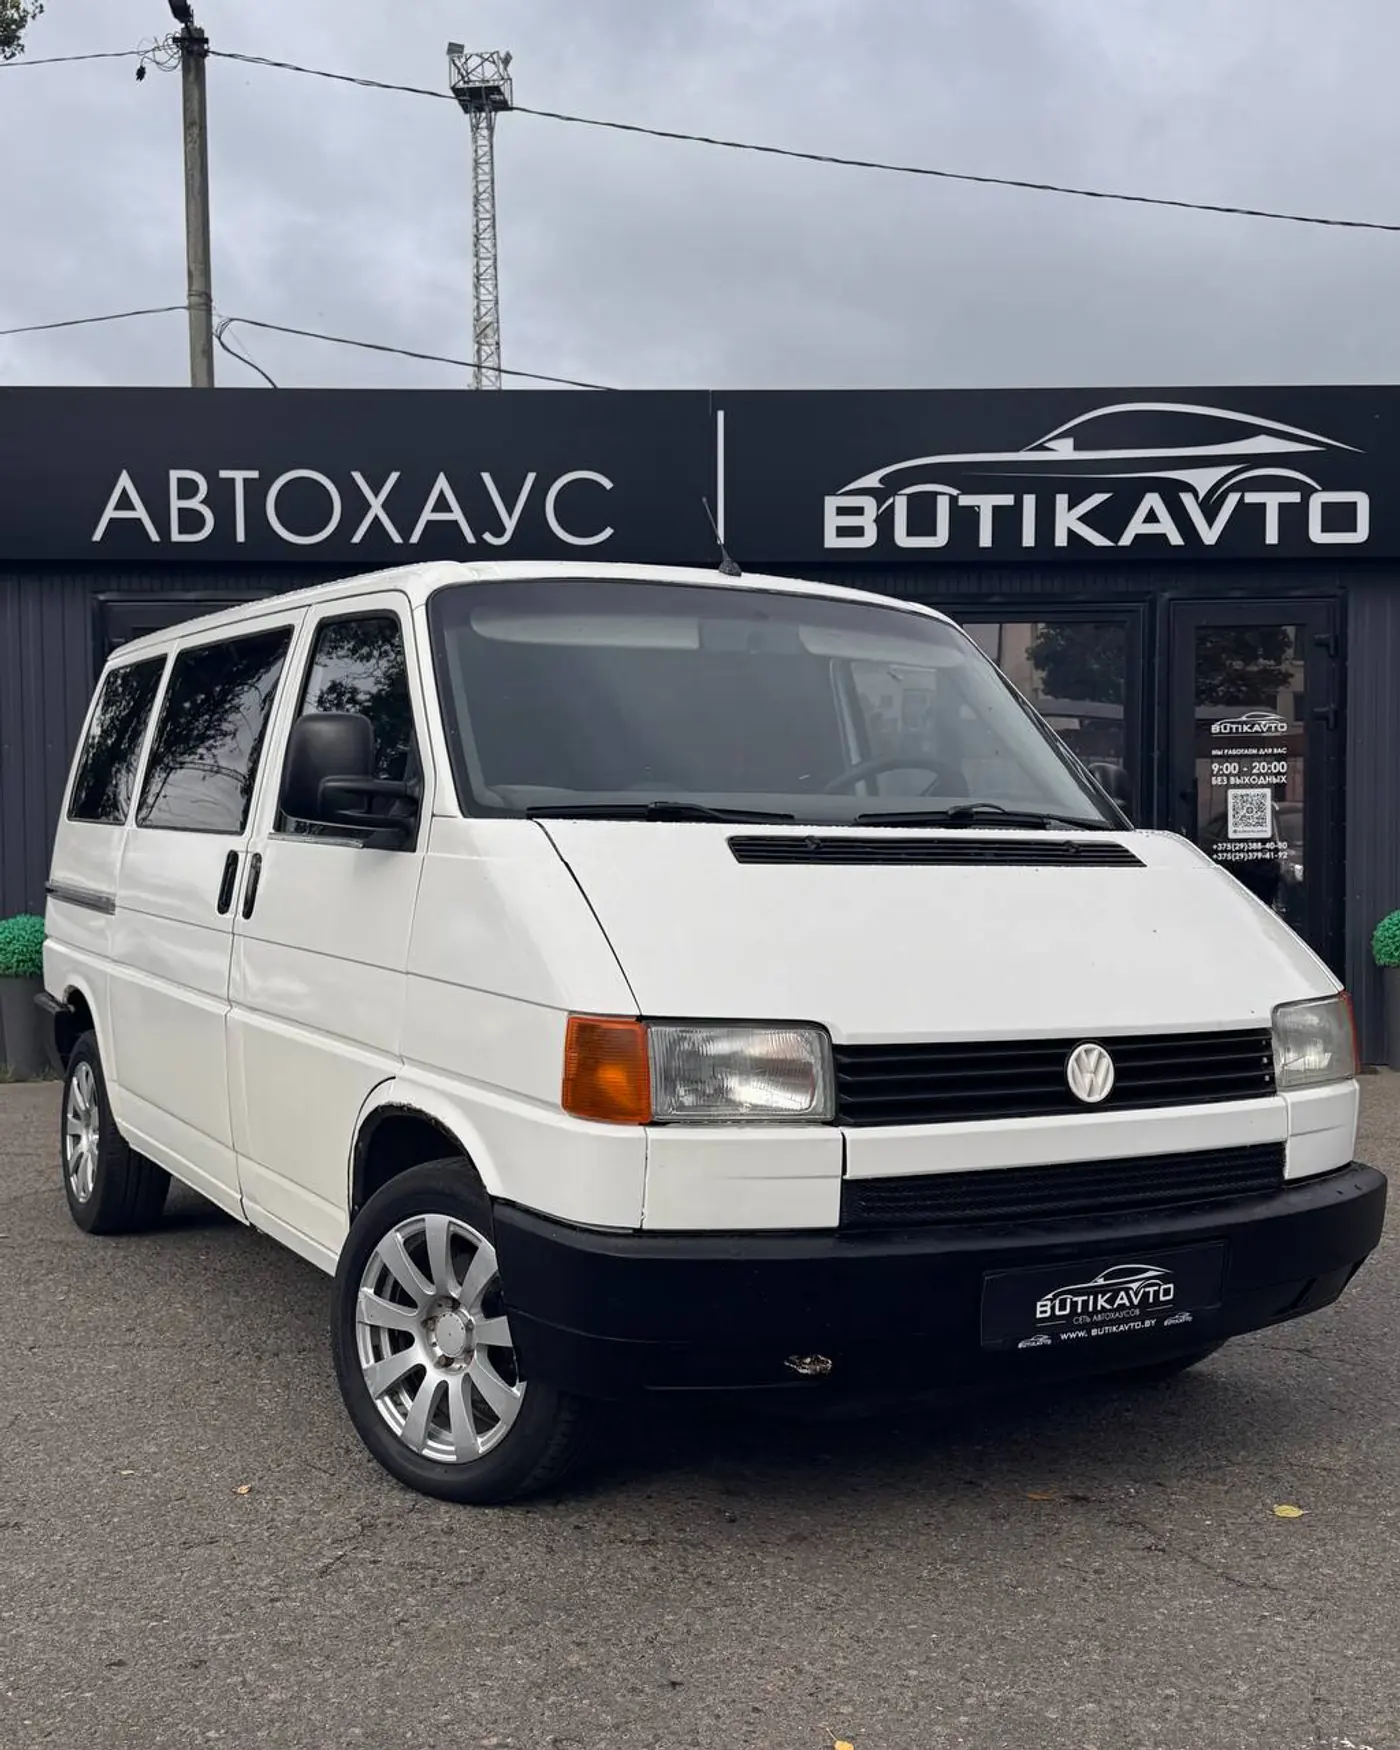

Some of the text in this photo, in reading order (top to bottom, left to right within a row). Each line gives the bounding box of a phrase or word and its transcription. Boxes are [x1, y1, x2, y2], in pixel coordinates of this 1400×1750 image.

[91, 468, 613, 546] АВТОХАУС
[824, 490, 1370, 549] BUTIKAVTO
[1211, 723, 1287, 733] BUTIKAVTO
[1211, 762, 1239, 774] 9:00
[1252, 761, 1287, 773] 20:00
[1211, 775, 1287, 785] БЕЗ ВЫХОДНЫХ
[1036, 1283, 1174, 1318] BUTIKAVTO
[1059, 1318, 1156, 1340] WWW. BUTIKAVTO.BY
